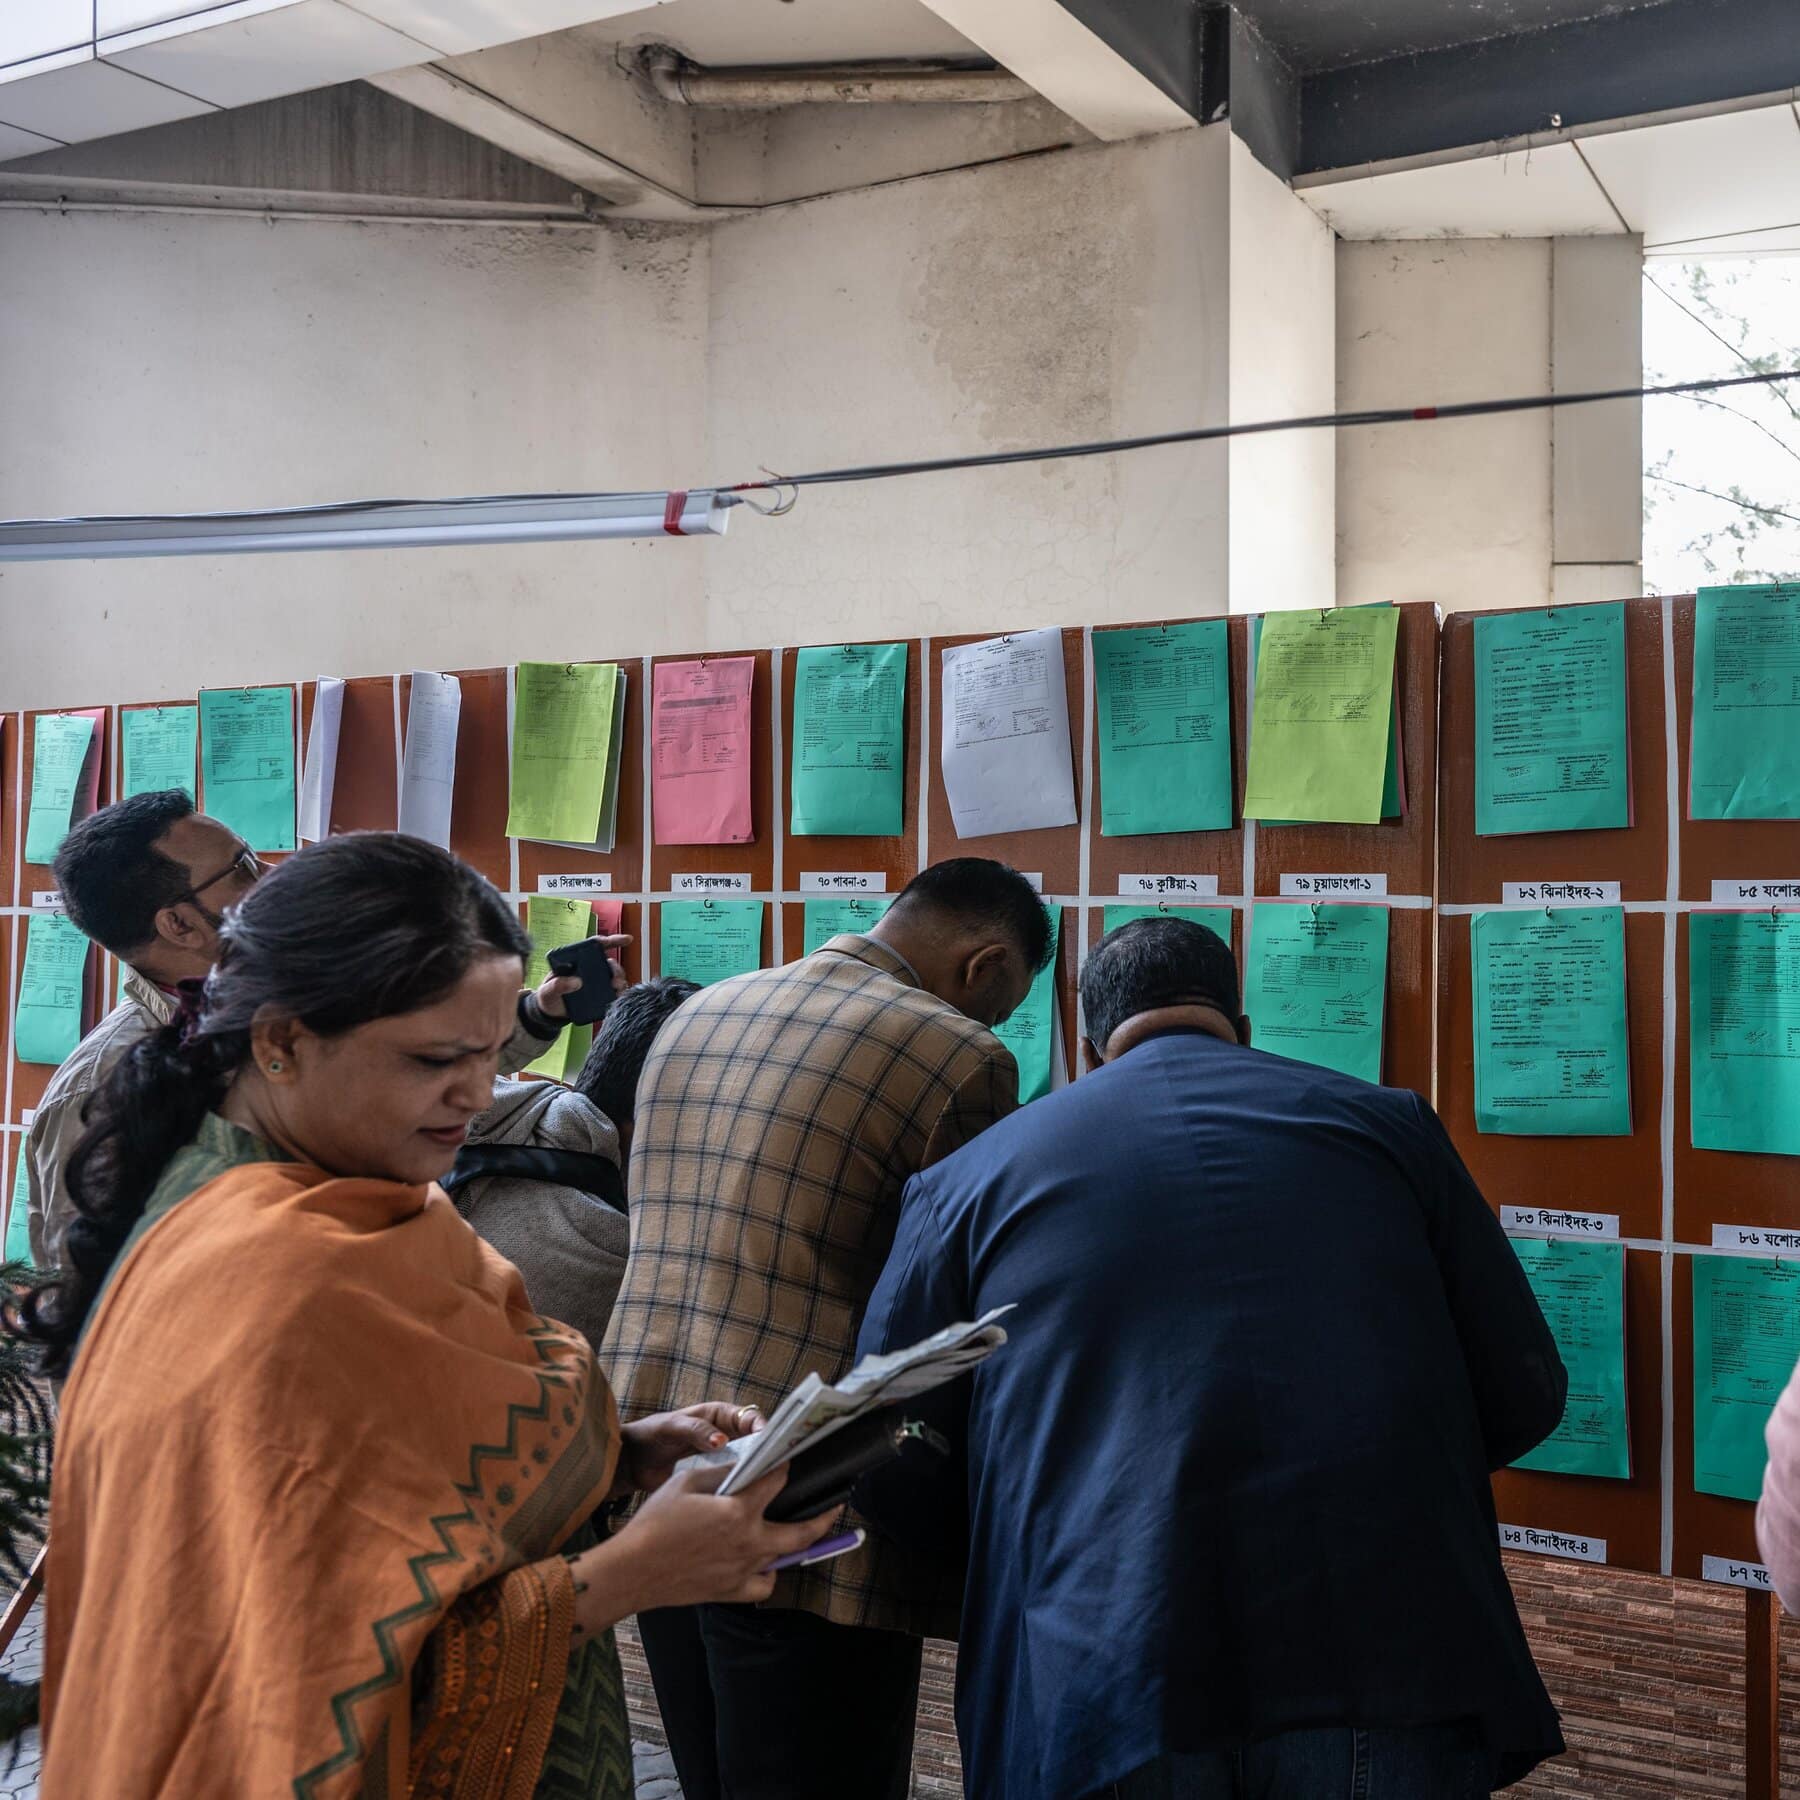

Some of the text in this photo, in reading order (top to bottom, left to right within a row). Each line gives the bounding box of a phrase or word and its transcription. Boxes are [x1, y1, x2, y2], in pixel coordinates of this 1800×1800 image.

[546, 875, 602, 888] ৬৪ সিরাজগঞ্জ-৩
[681, 875, 742, 889] ৬৭ সিরাজগঞ্জ-৬
[818, 876, 867, 888] ৭০ পাবনা-৩
[1138, 876, 1198, 893] ৭৬ কুষ্টিয়া-২
[1295, 878, 1372, 893] ৭৯ চুয়াডাংগা-১
[1519, 884, 1604, 900] ৮২ ঝিনাইদহ-২
[1739, 886, 1757, 898] ৮৫
[1515, 1210, 1604, 1231] ৮৩ ঝিনাইদহ-৩
[1739, 1231, 1760, 1245] ৮৬
[1504, 1530, 1589, 1554] ৮৪ ঝিনাইদহ-৪
[1729, 1565, 1748, 1581] ৮৭
